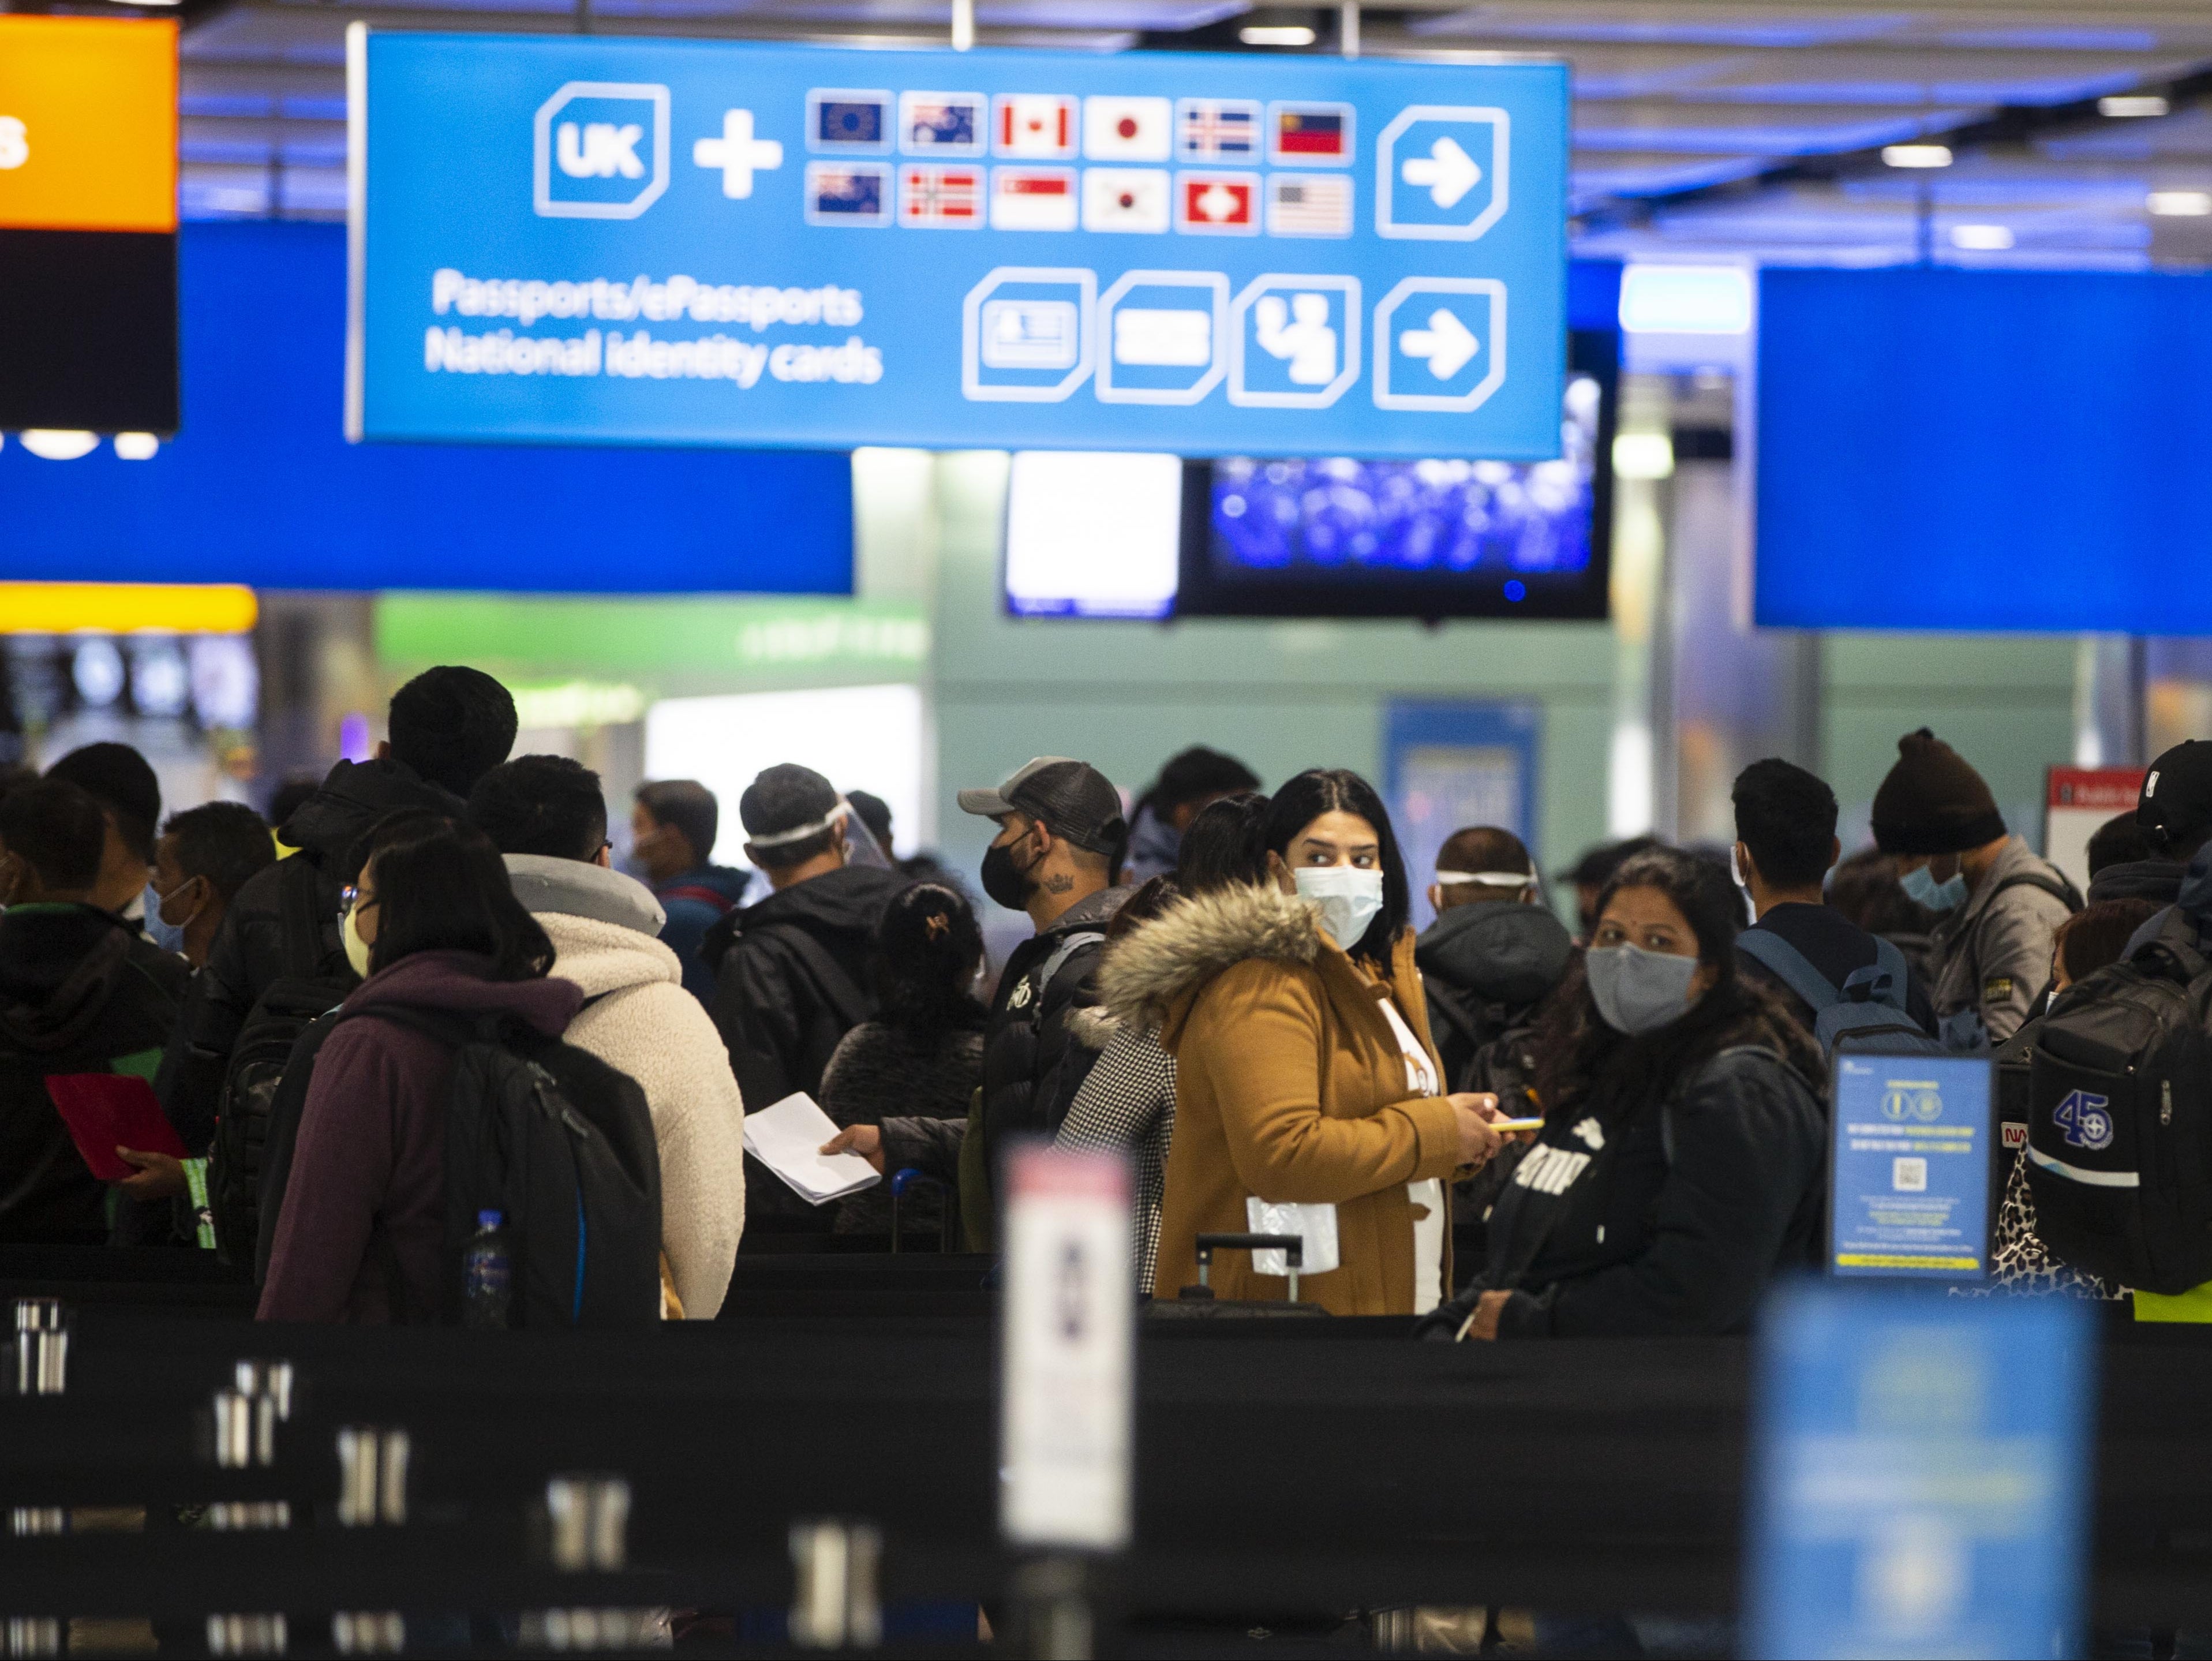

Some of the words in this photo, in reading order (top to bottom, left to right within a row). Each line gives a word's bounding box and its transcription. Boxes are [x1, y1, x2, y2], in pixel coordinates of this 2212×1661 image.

[557, 122, 645, 179] UK
[434, 270, 863, 331] Passports/ePassports
[426, 328, 601, 375] National
[606, 331, 769, 388] identity
[769, 336, 884, 385] cards
[2054, 1090, 2113, 1149] 45
